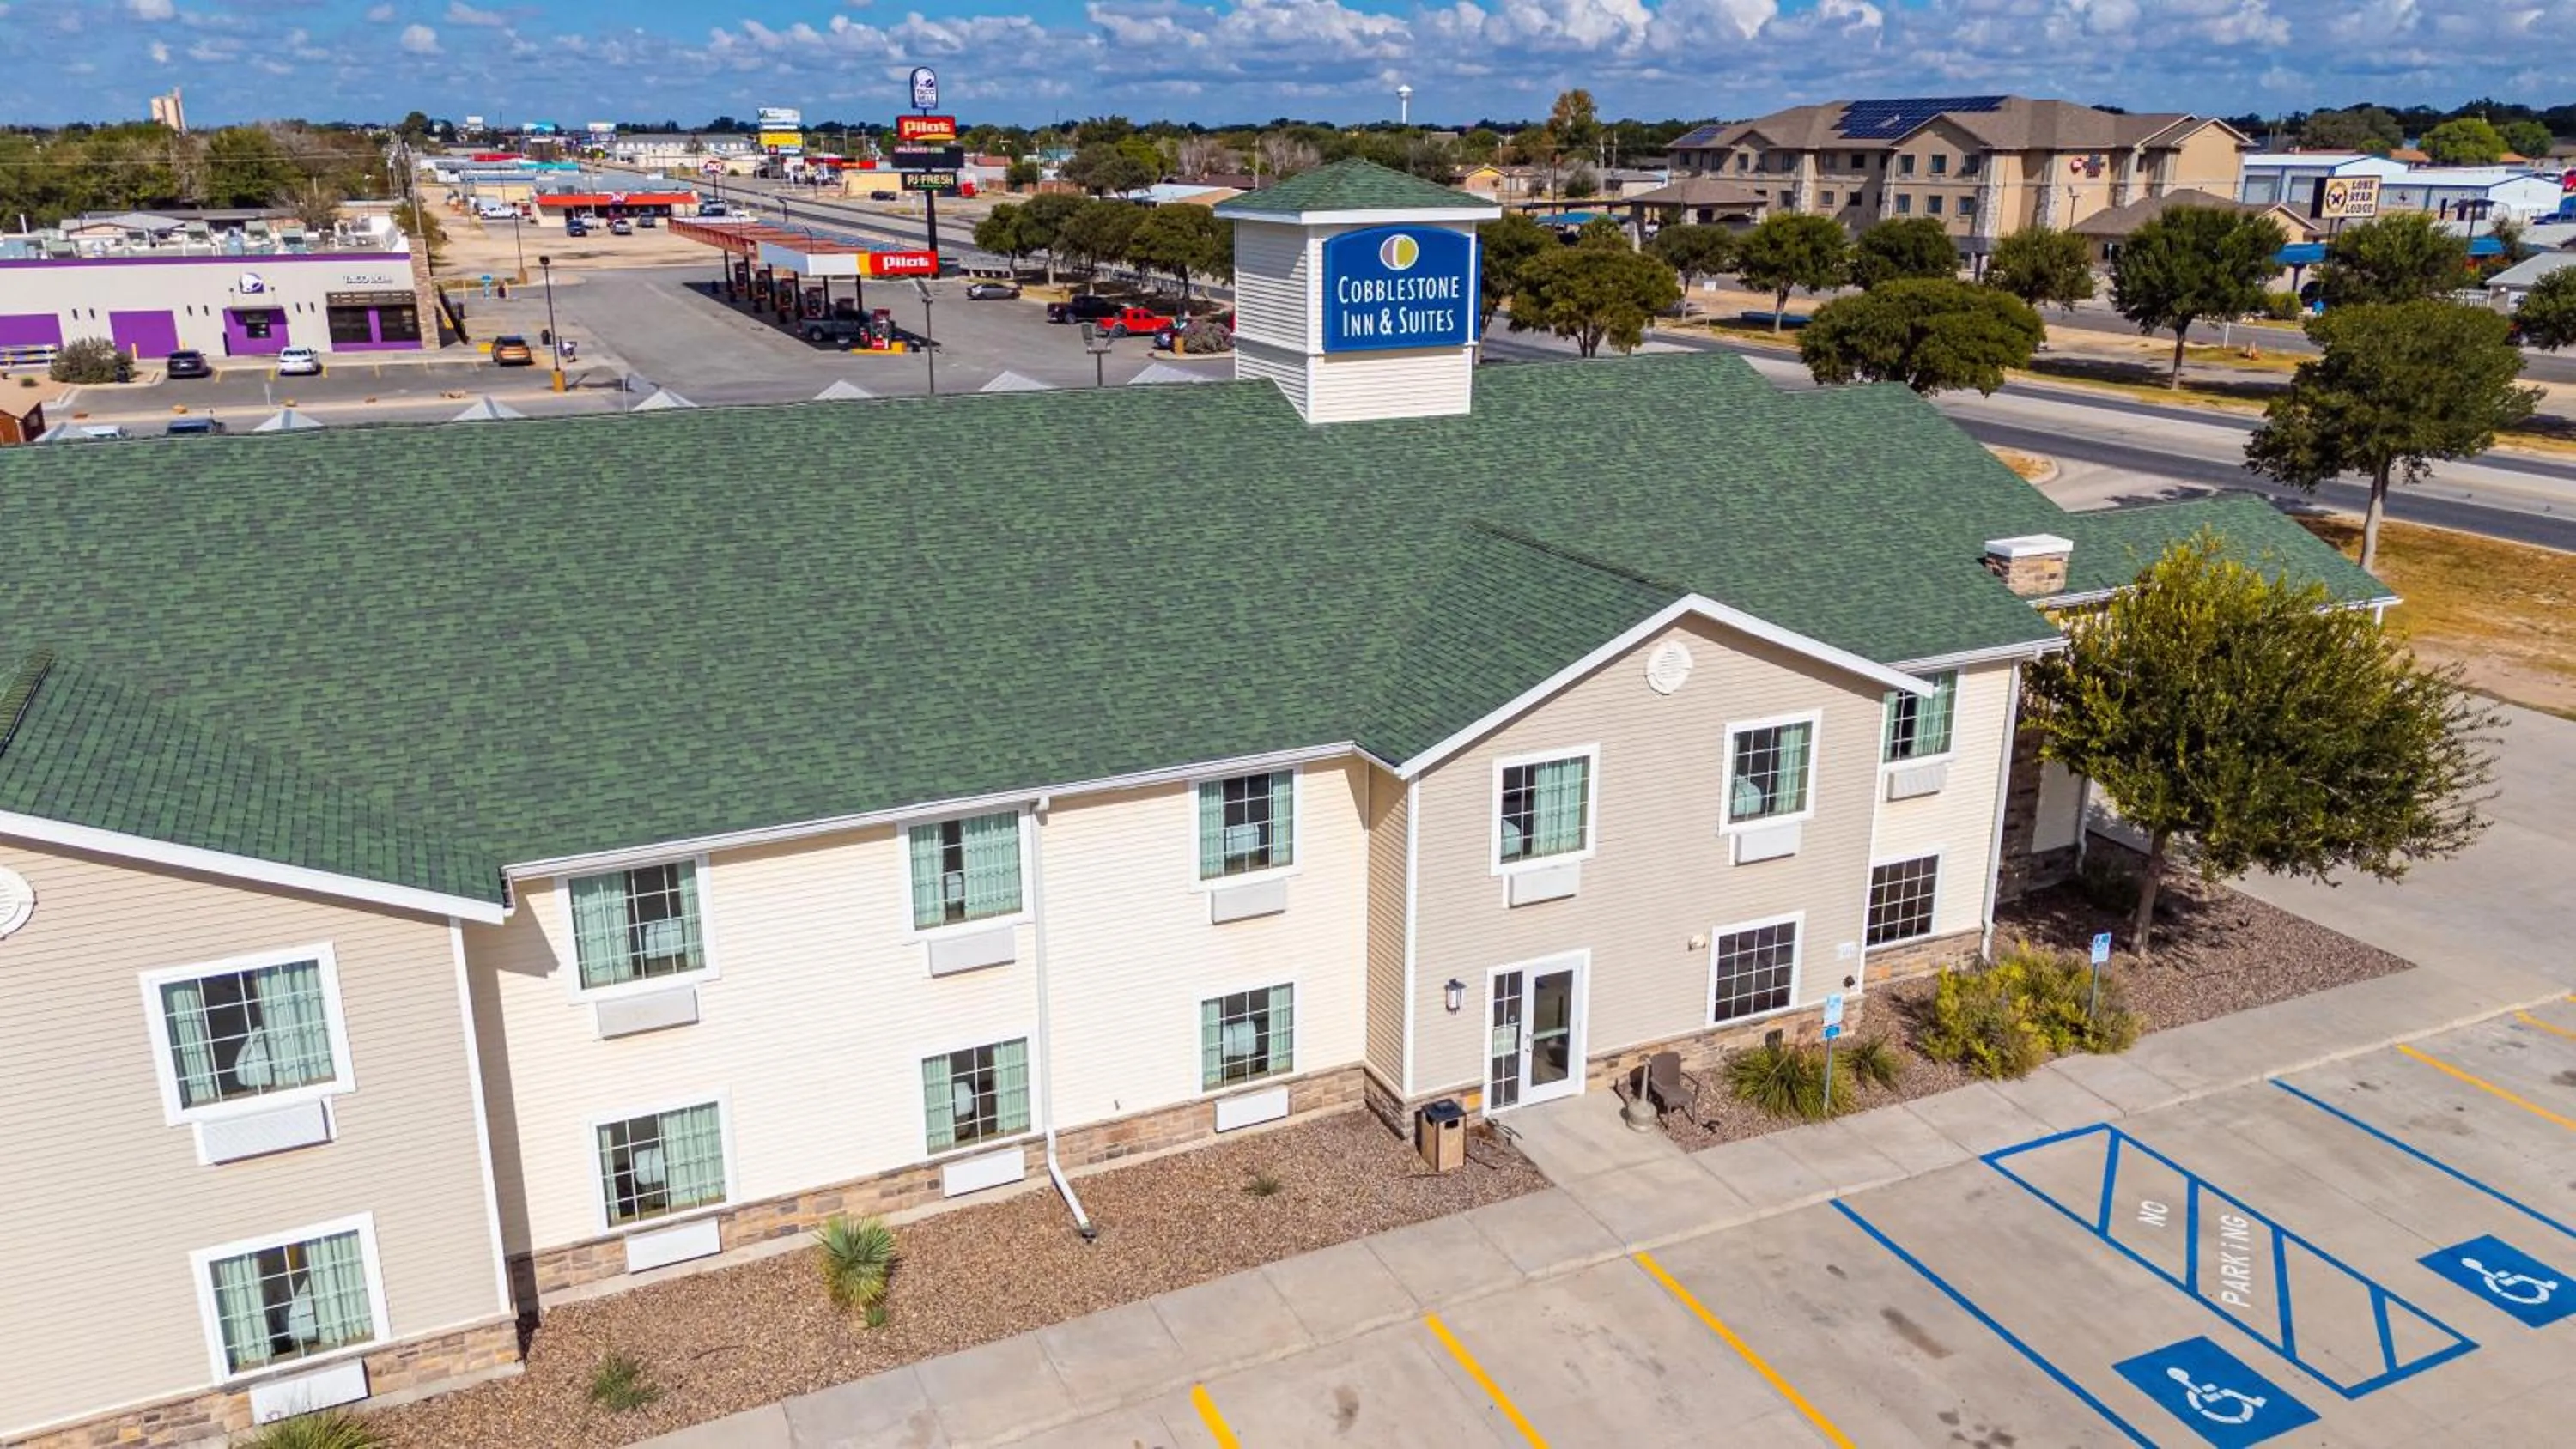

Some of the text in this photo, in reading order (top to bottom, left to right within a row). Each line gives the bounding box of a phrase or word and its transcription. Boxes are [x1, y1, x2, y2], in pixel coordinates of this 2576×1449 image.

[2351, 180, 2374, 190] LONE
[2345, 203, 2374, 214] LODGE
[1338, 276, 1461, 305] COBBLESTONE
[1343, 306, 1455, 337] INN & SUITES
[2136, 1200, 2169, 1228] NO
